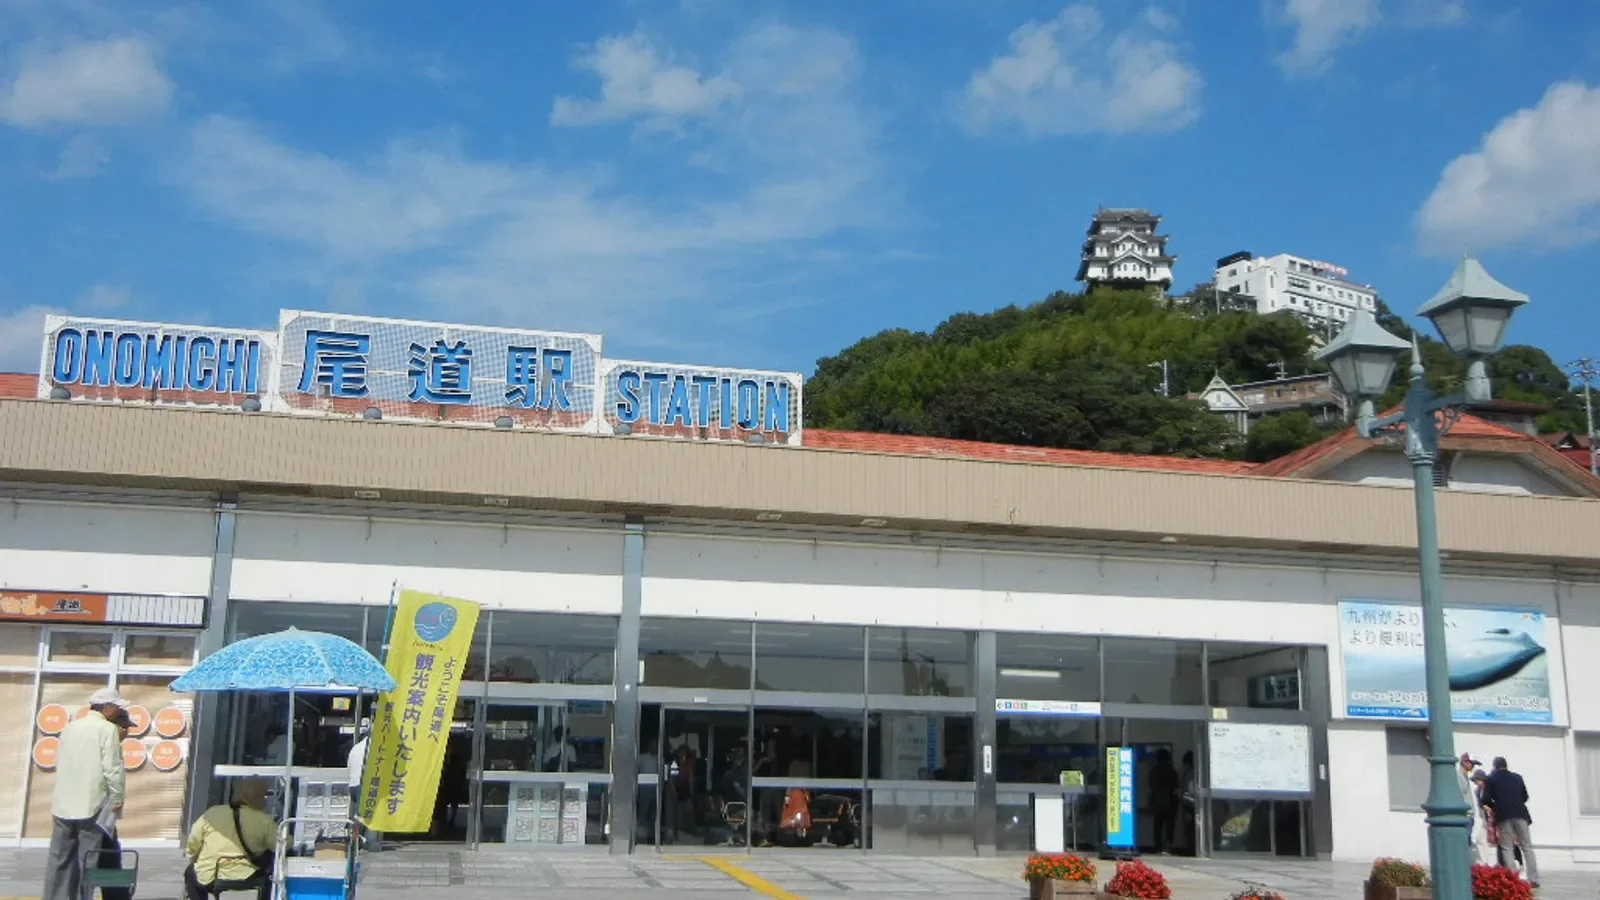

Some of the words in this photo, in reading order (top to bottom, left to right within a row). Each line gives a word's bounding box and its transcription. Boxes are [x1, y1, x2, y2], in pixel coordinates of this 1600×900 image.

[53, 328, 262, 394] ONOMICHI
[297, 329, 573, 412] 尾道駅
[615, 370, 790, 433] STATION
[1349, 630, 1424, 648] より便利に
[386, 652, 436, 816] 観光案内いたします
